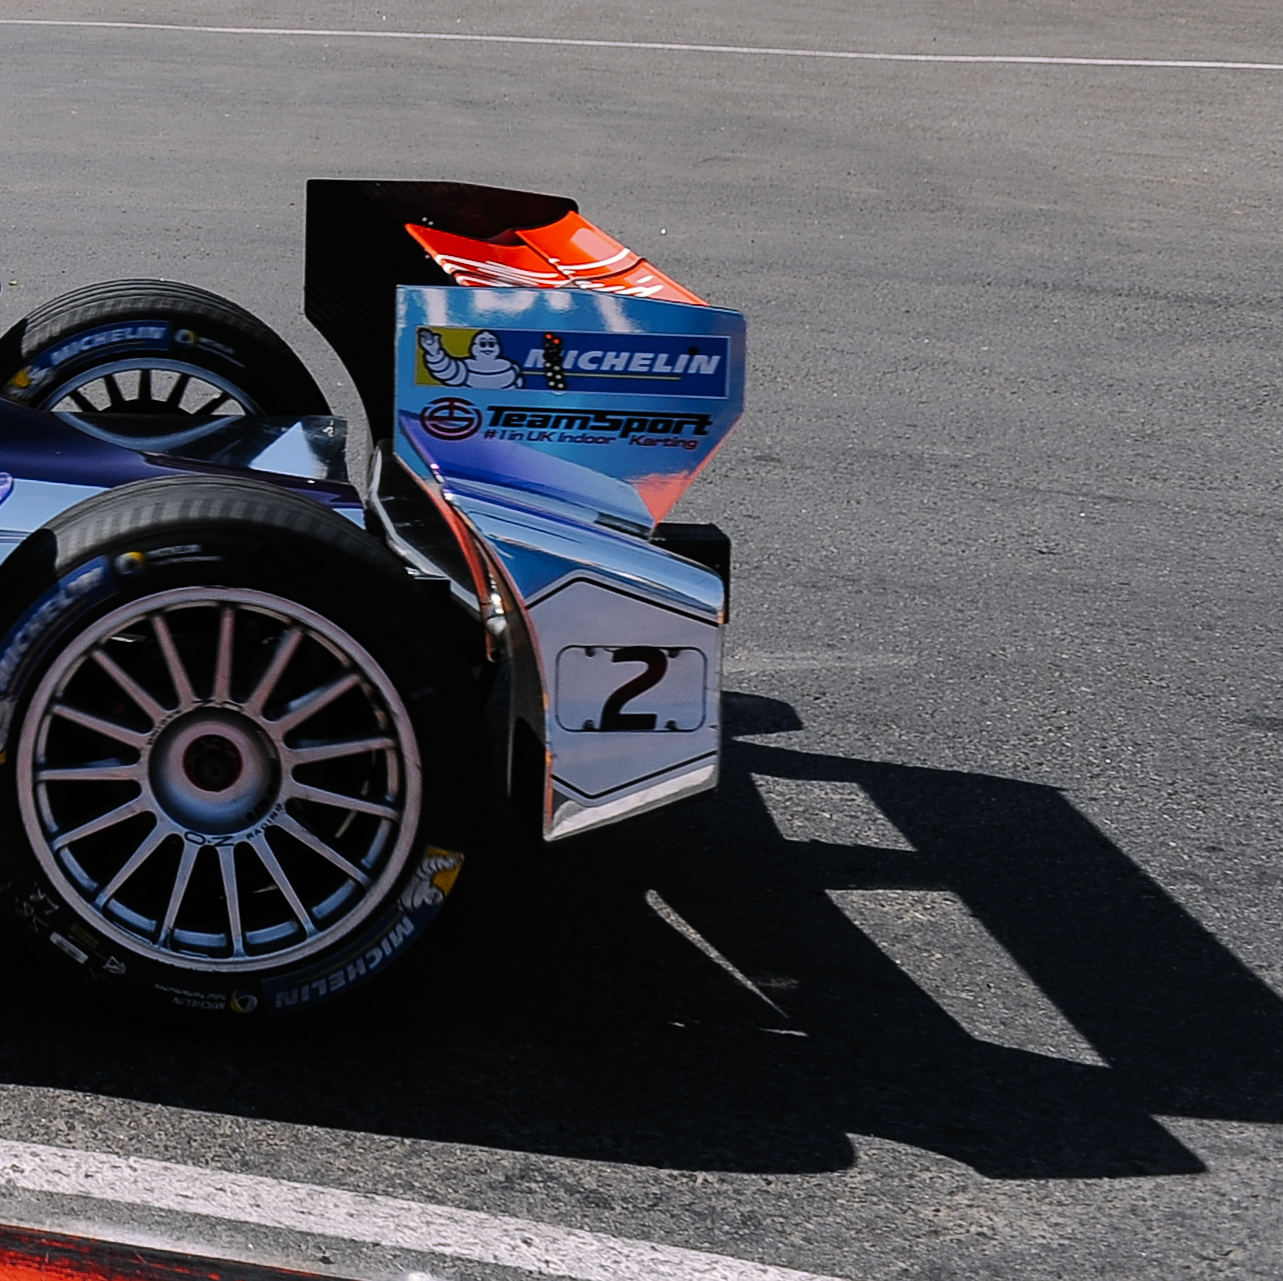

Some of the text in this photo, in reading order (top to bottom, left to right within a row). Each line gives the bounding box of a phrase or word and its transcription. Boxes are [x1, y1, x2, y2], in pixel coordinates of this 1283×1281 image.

[523, 348, 722, 375] MICHELIN
[487, 406, 713, 438] TeamSport
[526, 430, 557, 442] UK
[558, 431, 617, 445] Indoor
[628, 434, 699, 451] Karting
[599, 646, 668, 730] 2
[275, 915, 416, 1009] MICHELIN
